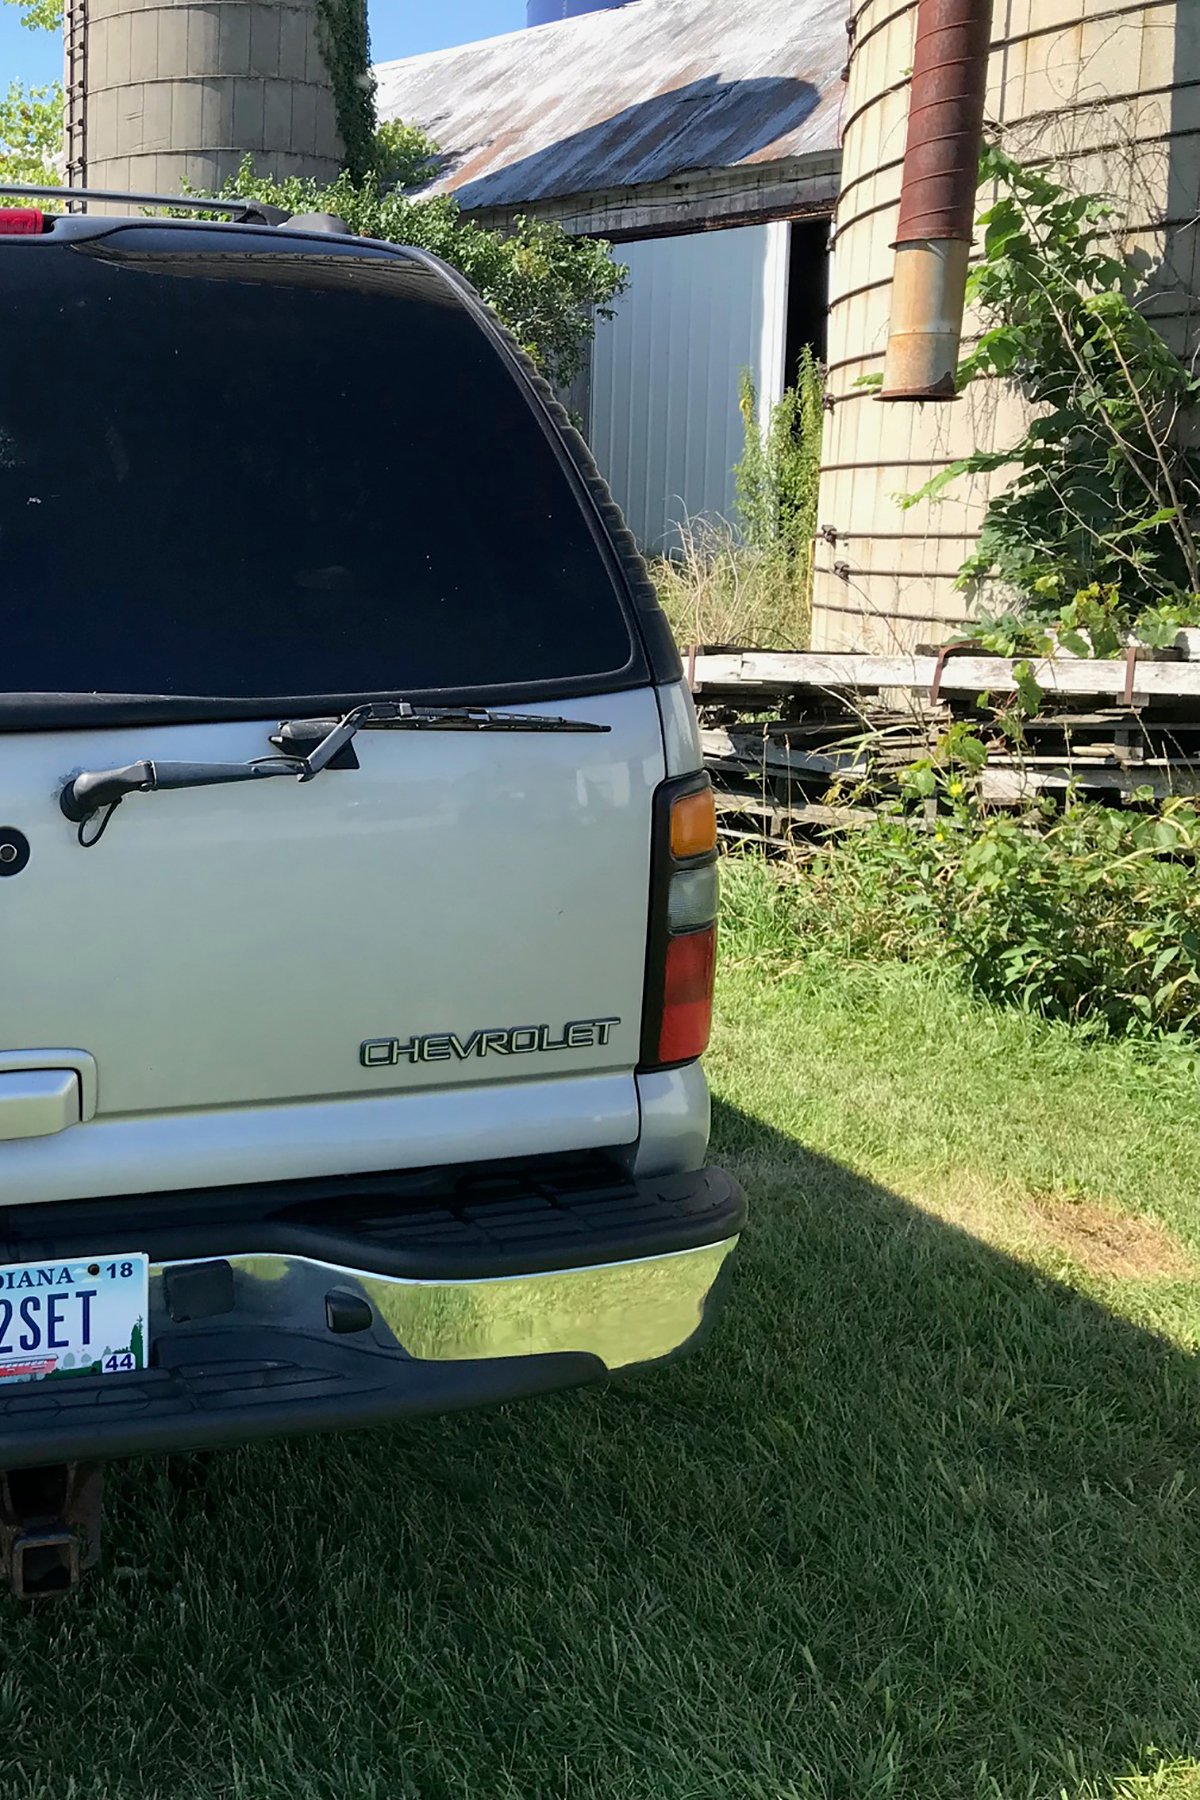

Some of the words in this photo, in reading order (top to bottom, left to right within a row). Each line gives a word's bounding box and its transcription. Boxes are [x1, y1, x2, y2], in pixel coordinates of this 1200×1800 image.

[360, 1017, 620, 1067] CHEVROLET
[105, 1262, 133, 1279] 18
[105, 1353, 133, 1371] 44
